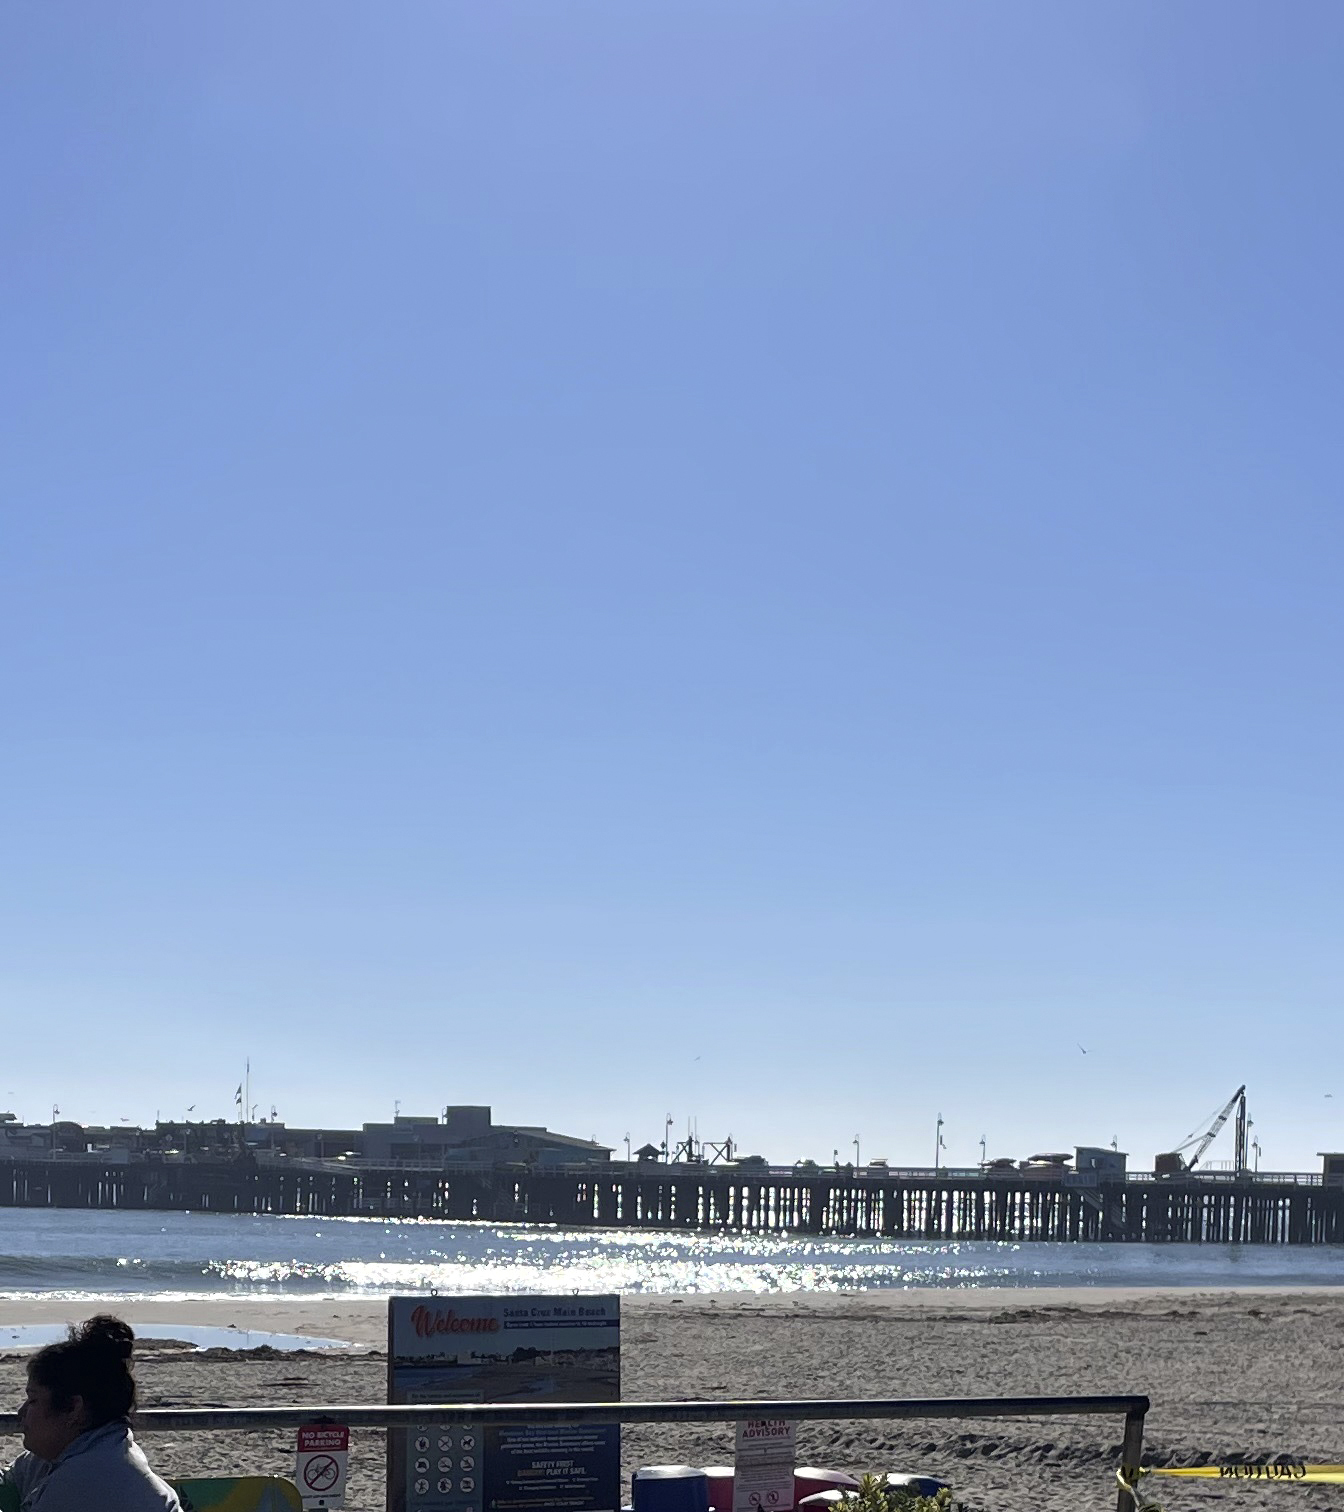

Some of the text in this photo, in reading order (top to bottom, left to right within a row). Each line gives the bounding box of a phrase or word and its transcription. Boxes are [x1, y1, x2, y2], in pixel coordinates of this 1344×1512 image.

[503, 1306, 606, 1317] Santa Cruz Main Beach
[411, 1304, 500, 1339] Welcome
[743, 1427, 791, 1438] ADVISORY
[304, 1439, 342, 1447] PARKING
